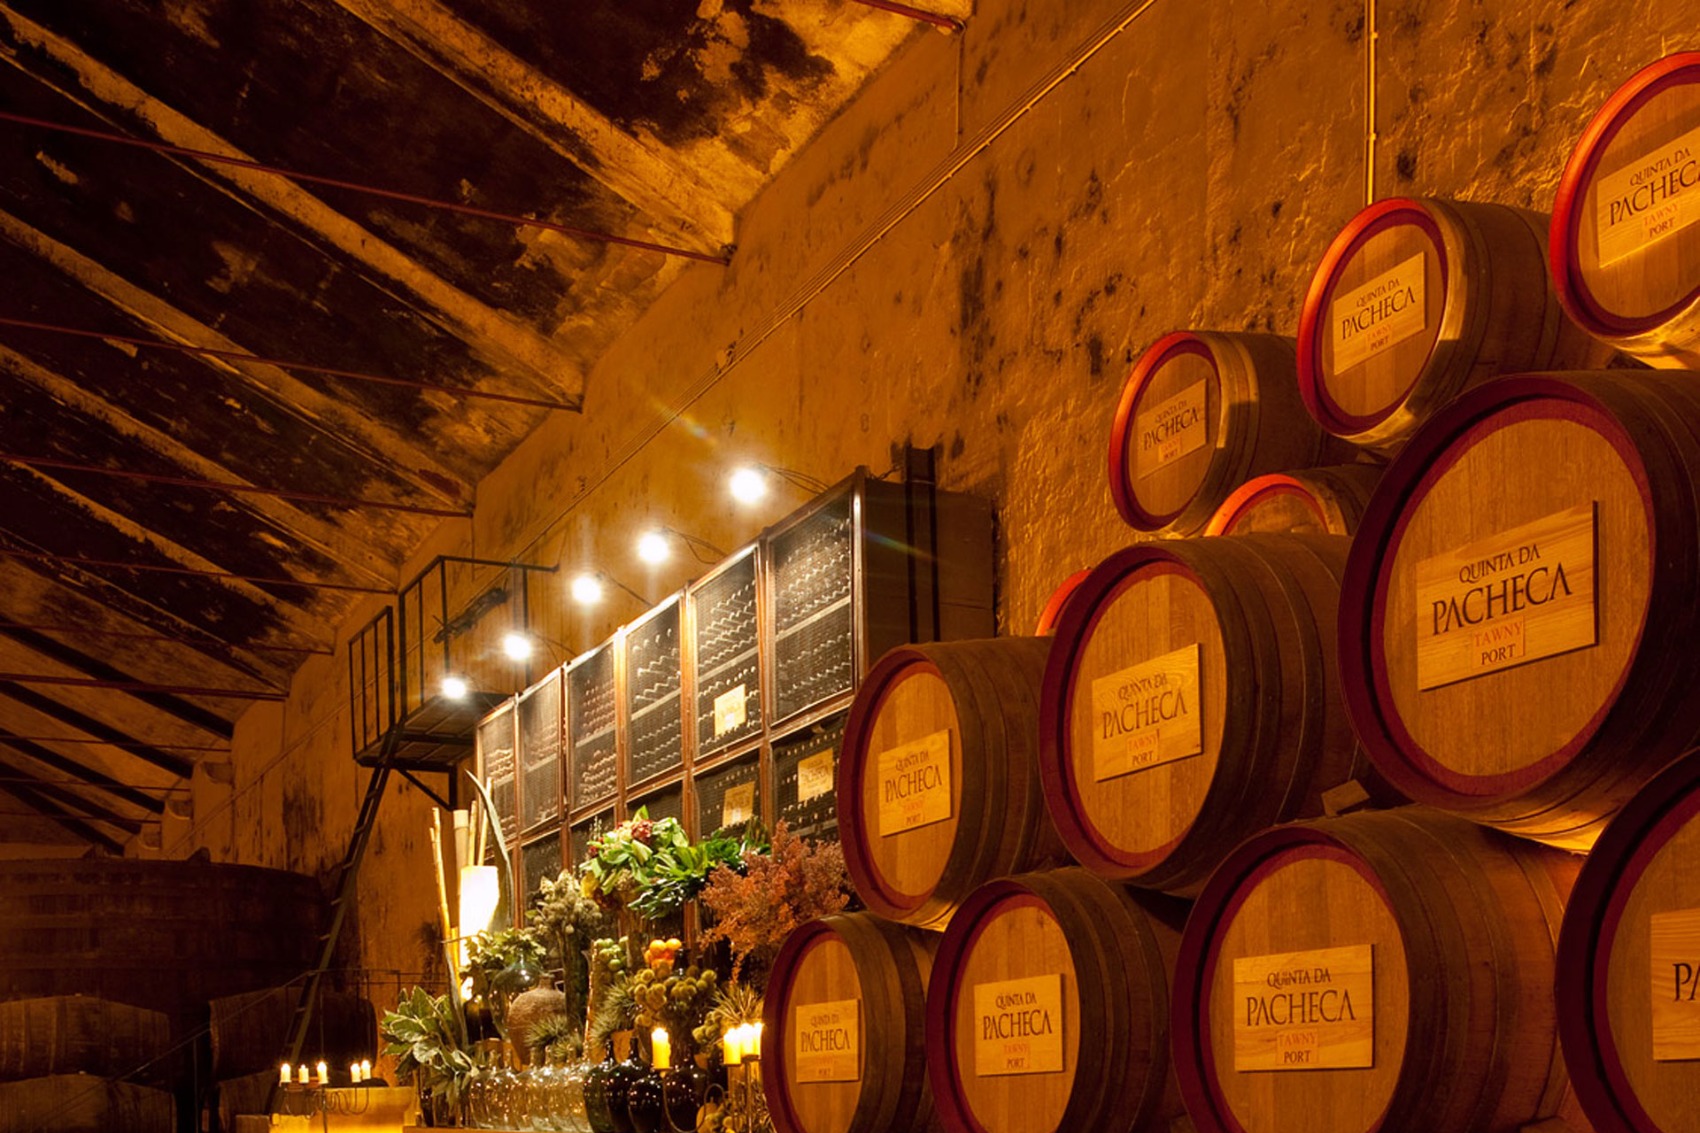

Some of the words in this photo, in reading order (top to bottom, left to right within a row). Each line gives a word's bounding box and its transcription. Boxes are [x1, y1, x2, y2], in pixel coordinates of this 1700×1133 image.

[1629, 156, 1672, 187] QUINTA
[1674, 147, 1692, 164] DA
[1608, 159, 1700, 227] PACHEC
[1643, 201, 1680, 227] TAWNY
[1649, 216, 1676, 239] PORT
[1356, 286, 1386, 308] QUINTA
[1388, 278, 1400, 293] DA
[1342, 286, 1415, 340] PACHECA
[1370, 336, 1389, 351] PORT
[1143, 406, 1198, 451] PACHECA
[1459, 552, 1513, 584] QUINTA
[1519, 544, 1542, 565] DA
[1432, 562, 1572, 636] PACHECA
[1475, 620, 1522, 648] TAWNY
[1481, 644, 1516, 666] PORT
[1118, 677, 1152, 701] QUINTA
[1153, 672, 1167, 690] DA
[1102, 688, 1188, 740] PACHECA
[1131, 750, 1154, 766] PORT
[885, 764, 942, 803] PACHECA
[1267, 969, 1311, 990] QUINTA
[1314, 967, 1332, 984] DA
[995, 993, 1024, 1011] QUINTA
[1025, 991, 1037, 1006] DA
[1246, 989, 1356, 1027] PACHECA
[983, 1009, 1053, 1041] PACHECA
[1279, 1031, 1317, 1047] TAWNY
[800, 1028, 850, 1053] PACHECA
[1006, 1057, 1025, 1070] PORT
[1283, 1050, 1311, 1064] PORT
